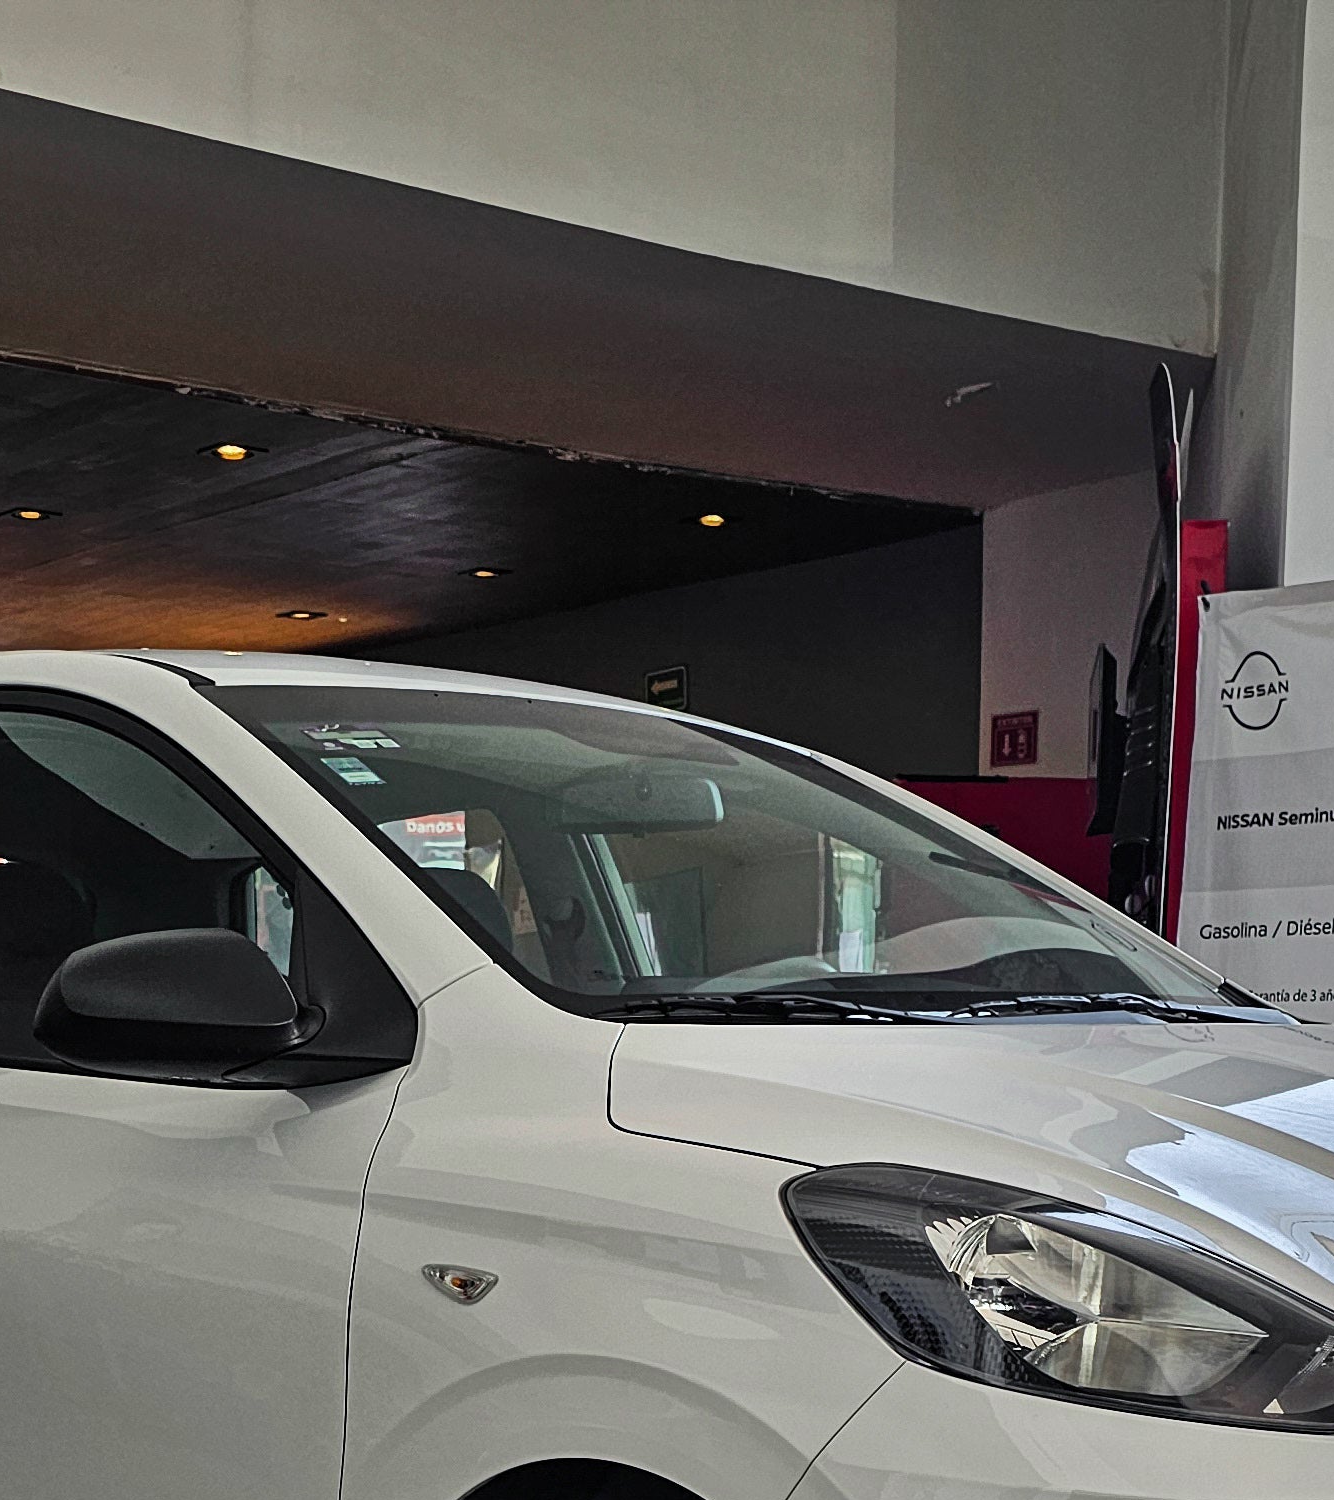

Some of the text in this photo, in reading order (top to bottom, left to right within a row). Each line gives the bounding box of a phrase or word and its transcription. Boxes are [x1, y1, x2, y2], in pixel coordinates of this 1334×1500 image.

[1220, 680, 1289, 701] NISSAN
[1217, 812, 1274, 831] NISSAN
[1199, 922, 1268, 940] Gasolina
[1272, 920, 1282, 938] /
[1248, 989, 1290, 1003] rantía
[1293, 989, 1308, 1002] de
[1310, 989, 1317, 1002] 3
